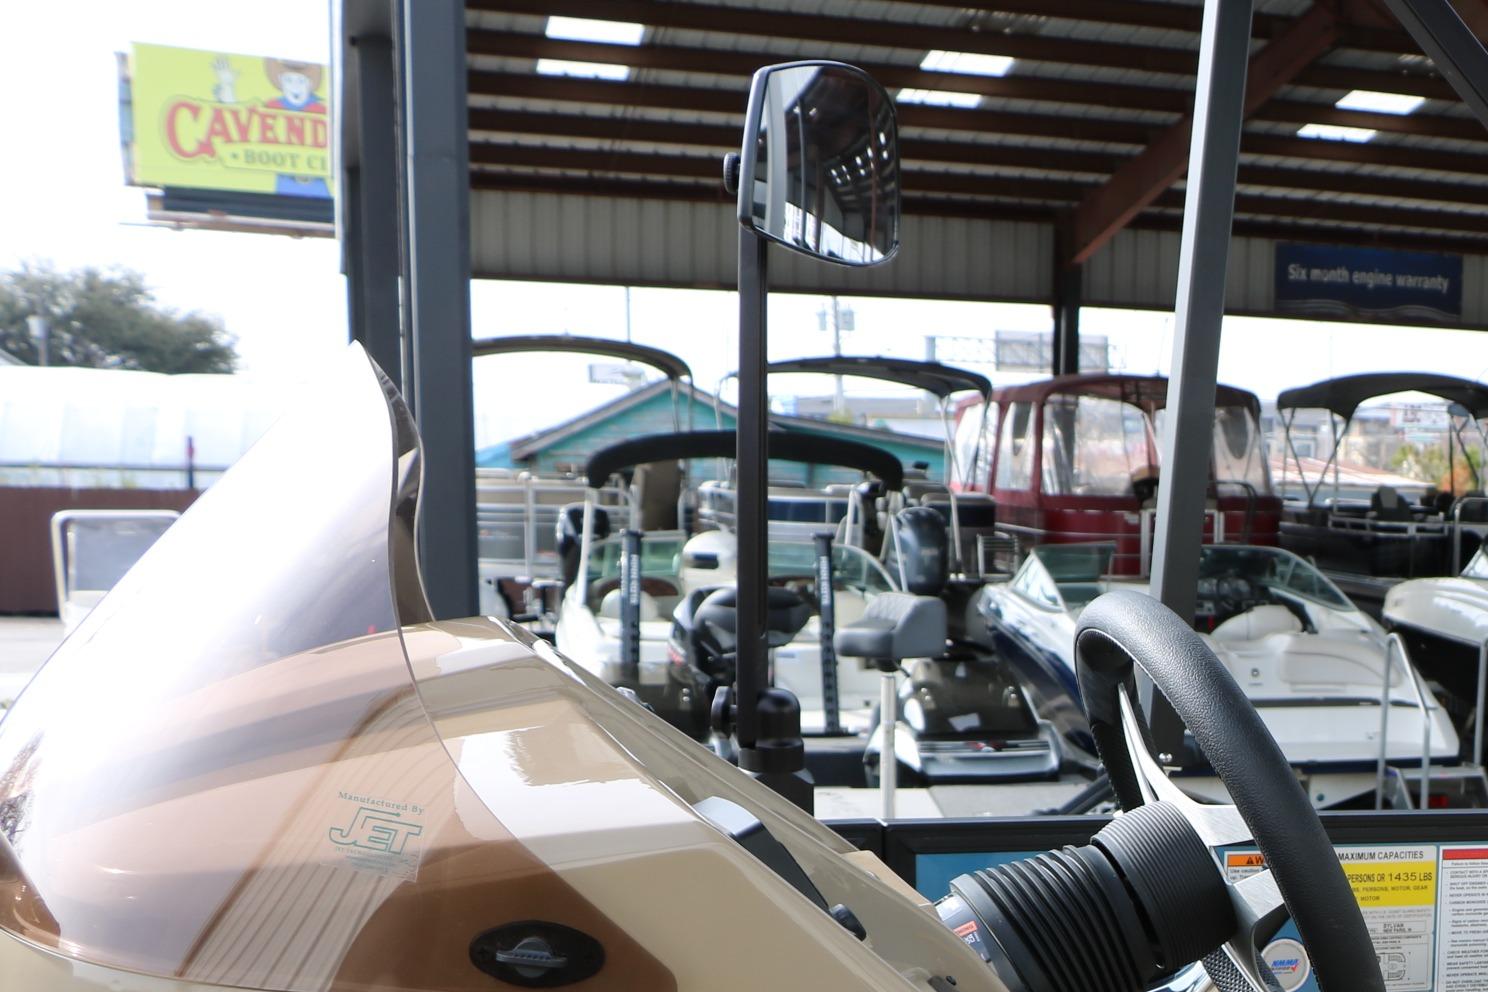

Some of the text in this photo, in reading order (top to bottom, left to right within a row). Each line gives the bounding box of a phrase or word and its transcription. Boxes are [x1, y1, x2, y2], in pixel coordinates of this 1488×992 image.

[166, 100, 328, 158] CAVEND
[243, 149, 299, 168] BOOT
[1287, 263, 1449, 294] Six month engine warranty
[338, 791, 424, 816] Manufactured By
[329, 807, 423, 855] JET
[1338, 851, 1424, 861] MAXIMUM CAPACITIES
[1348, 872, 1433, 883] PERSONS OR 1435 LBS
